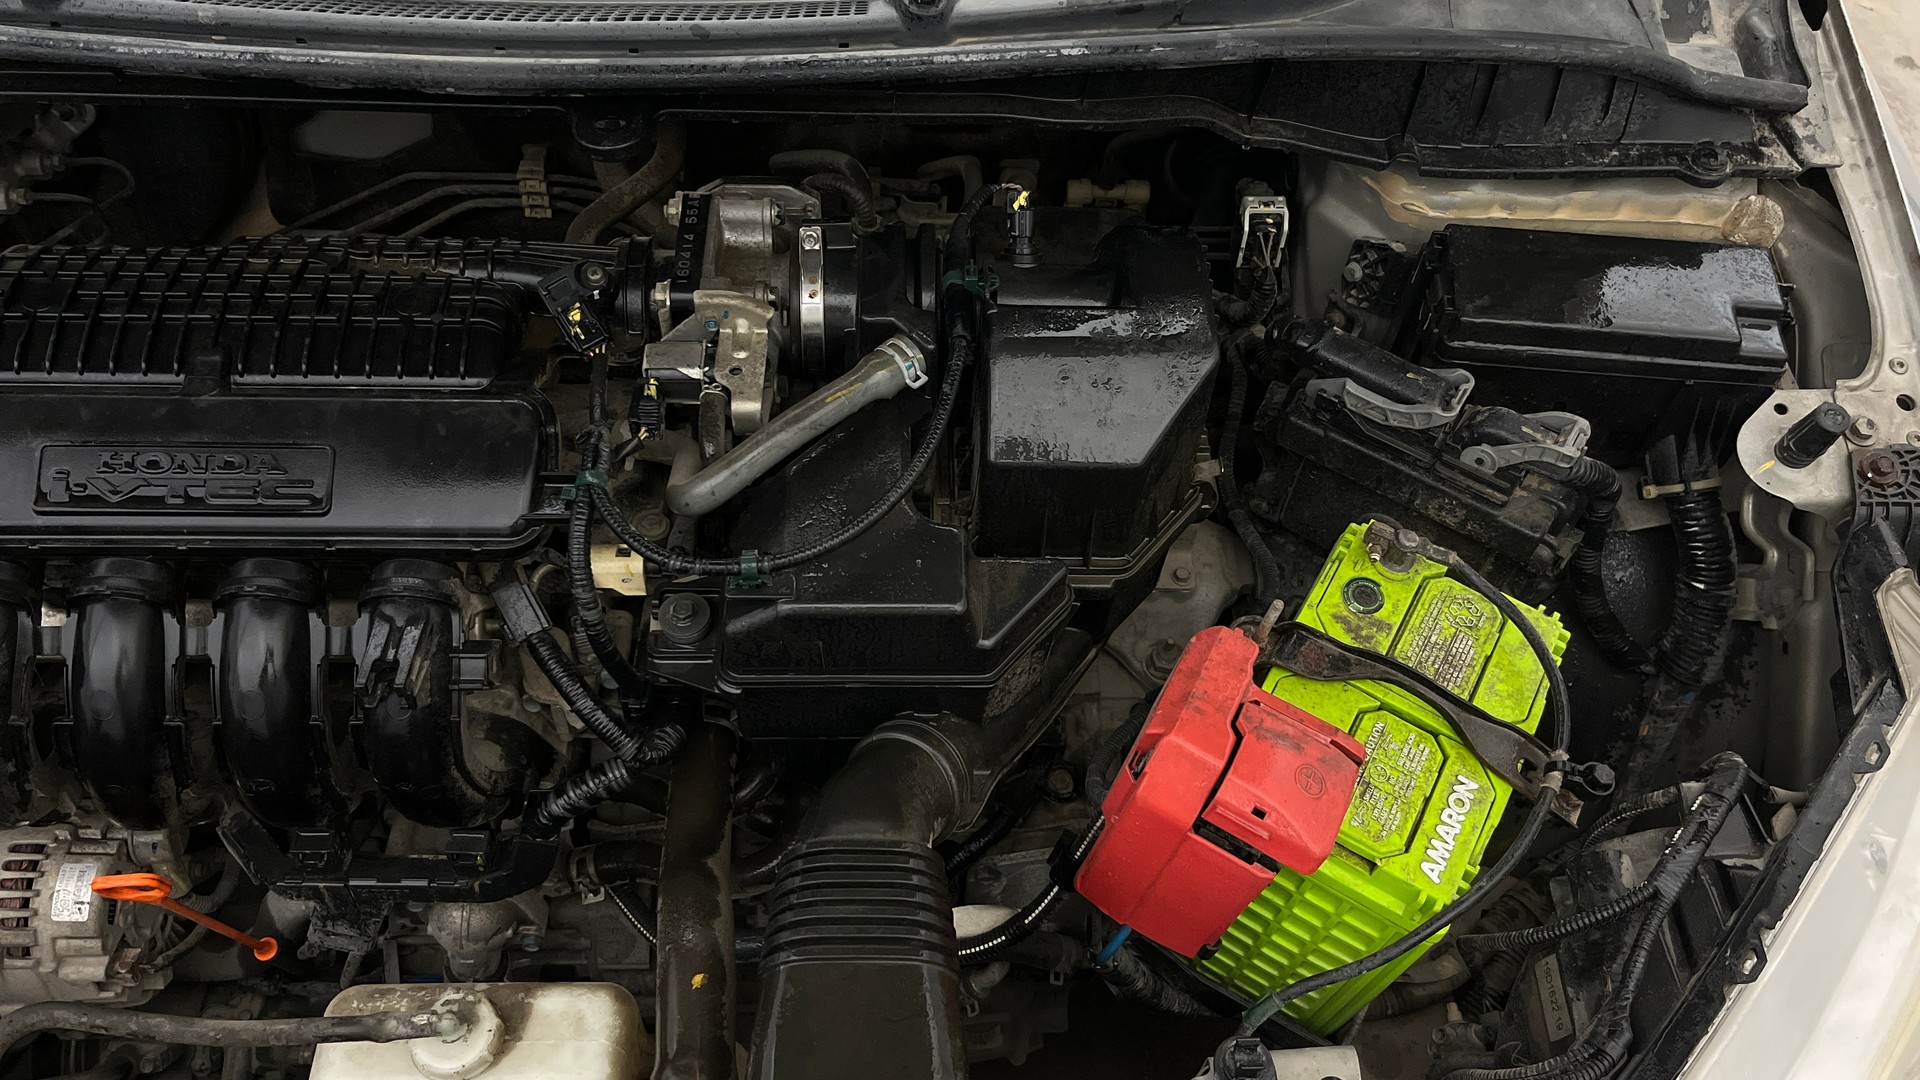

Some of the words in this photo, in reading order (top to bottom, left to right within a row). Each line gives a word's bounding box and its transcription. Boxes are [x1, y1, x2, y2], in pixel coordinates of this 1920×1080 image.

[677, 233, 693, 283] 160414
[96, 451, 288, 475] HONDA
[47, 467, 315, 505] i-VTEC
[1420, 774, 1480, 884] AMARON
[1554, 1016, 1564, 1031] 19
